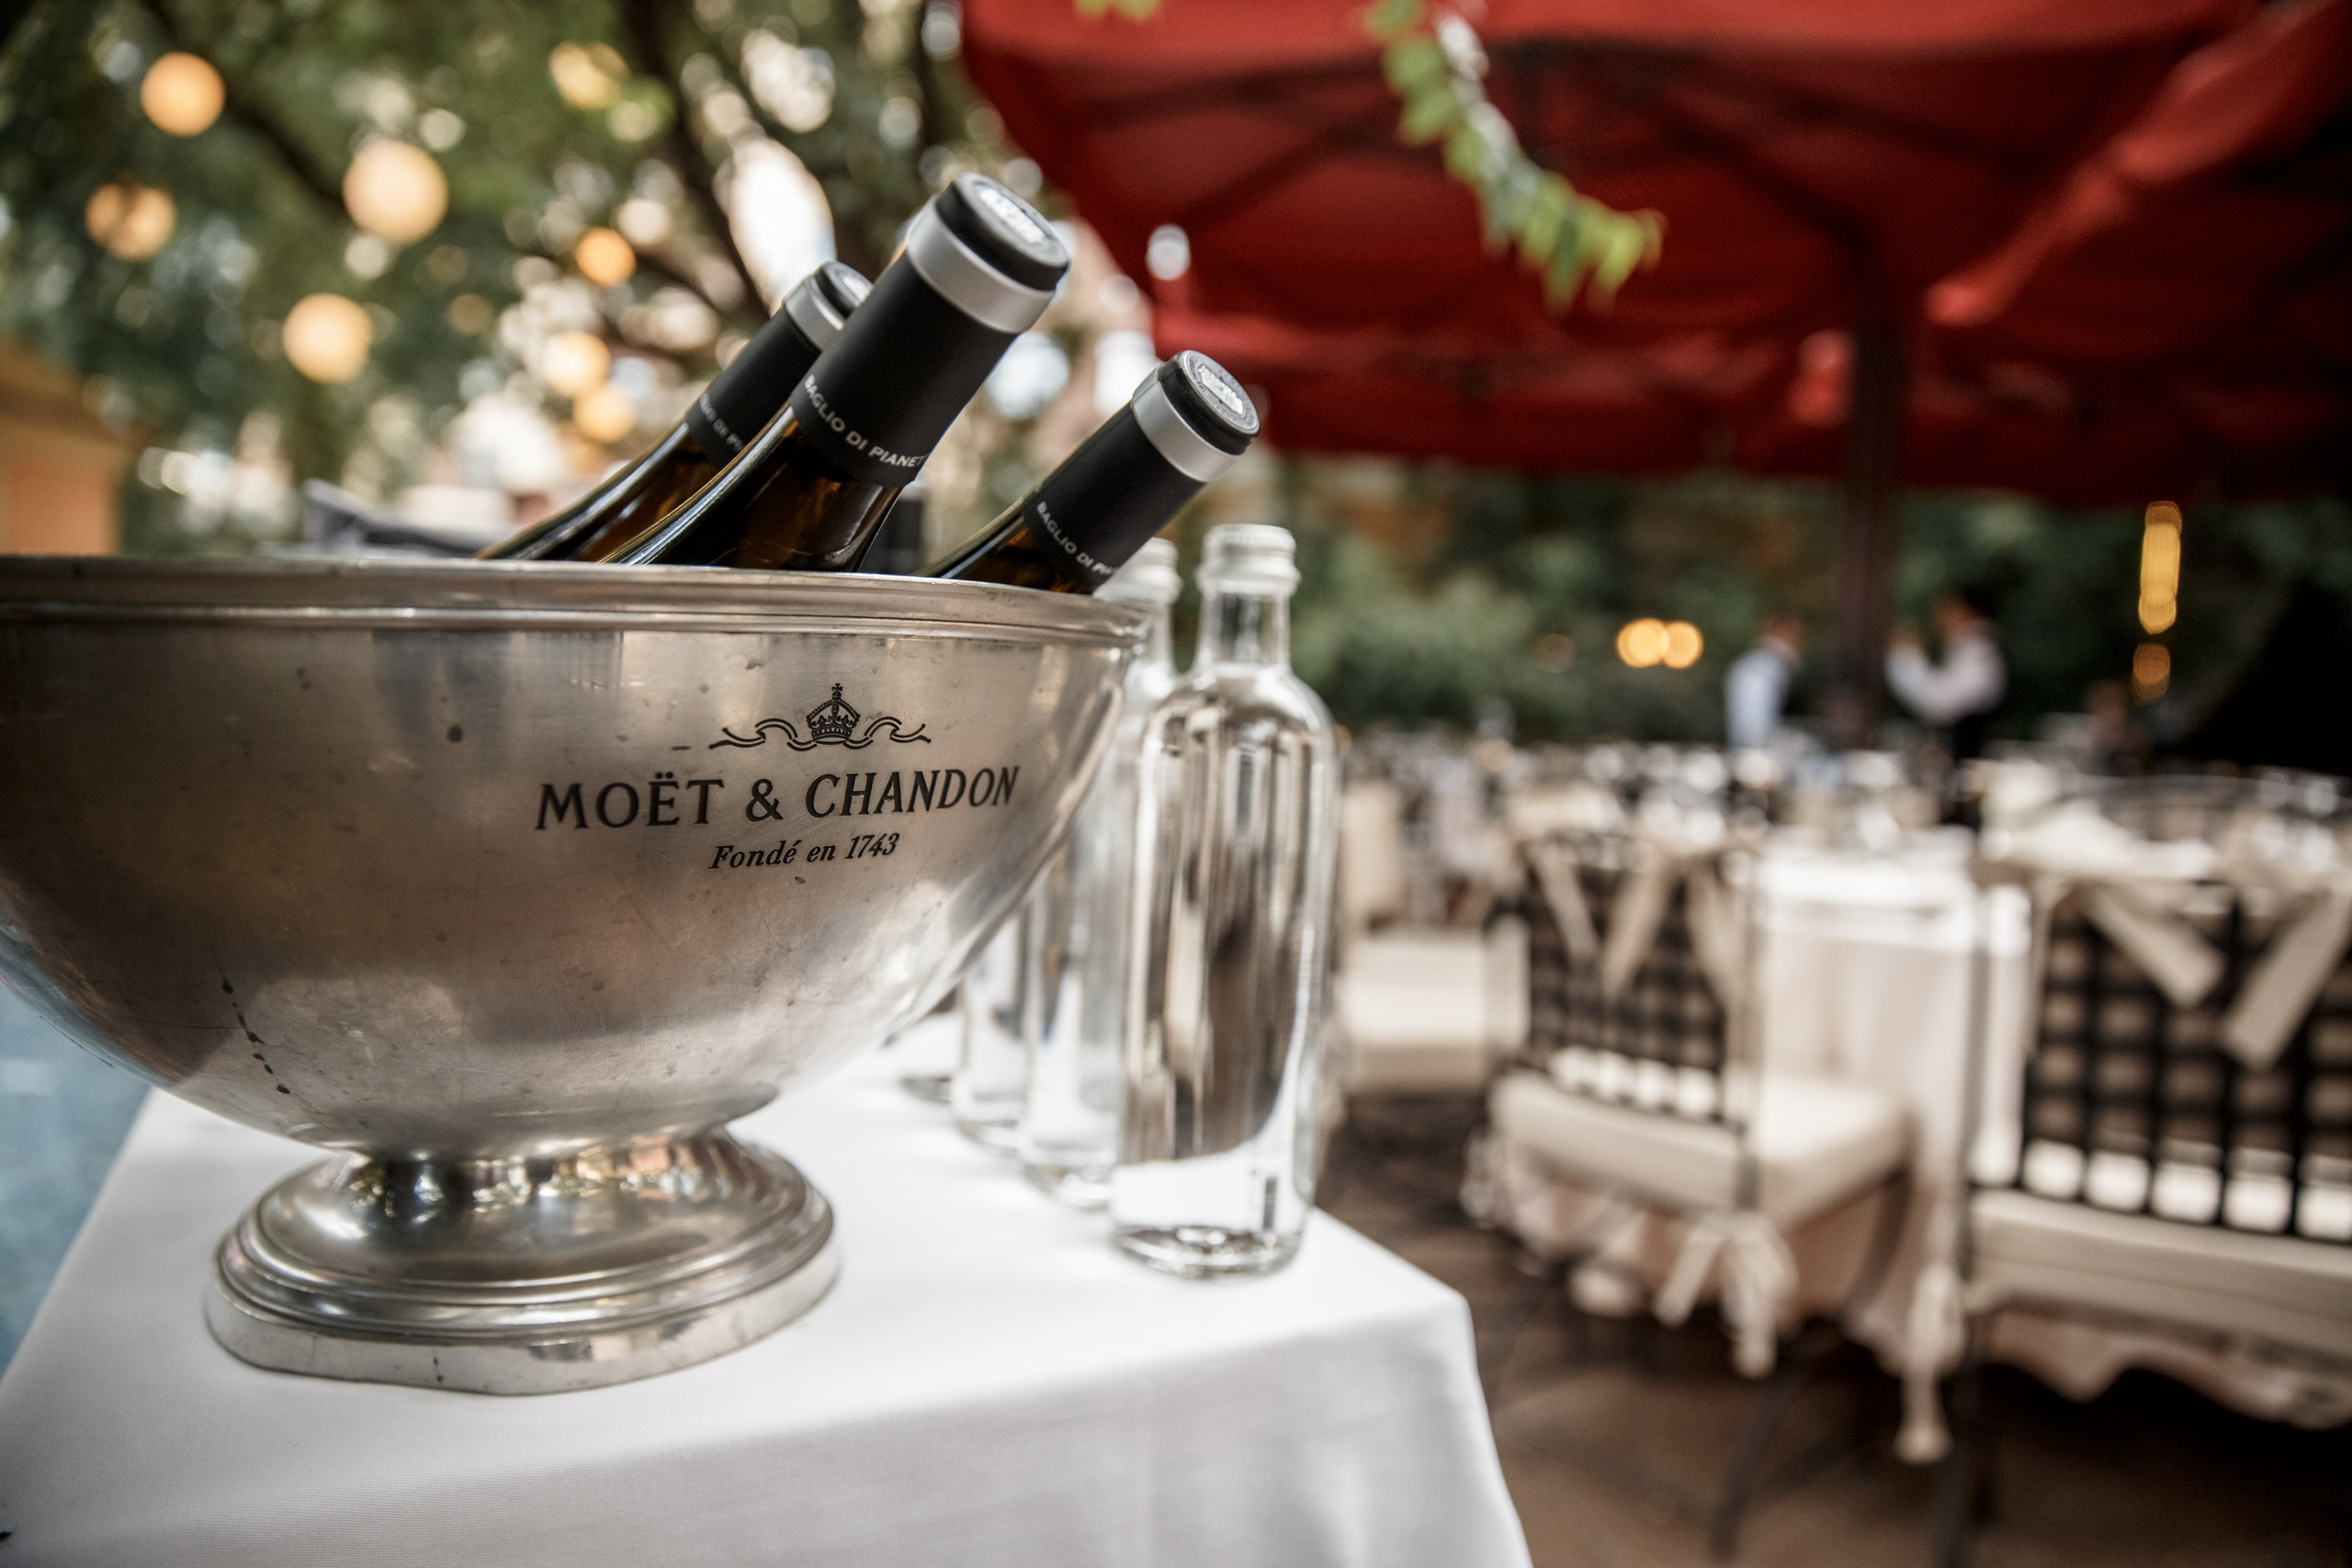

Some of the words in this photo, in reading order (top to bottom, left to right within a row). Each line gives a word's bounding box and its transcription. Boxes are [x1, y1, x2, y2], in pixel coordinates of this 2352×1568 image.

[804, 376, 846, 433] BAGLIO
[845, 430, 868, 450] DI
[868, 446, 930, 467] PIANET
[1036, 502, 1077, 554] BAGLIO
[1076, 552, 1094, 567] DI
[537, 772, 724, 829] MOËT
[745, 778, 784, 822] &
[806, 766, 1021, 820] CHANDON
[708, 840, 802, 869] Fondé
[806, 844, 835, 862] en
[844, 833, 899, 860] 1743
